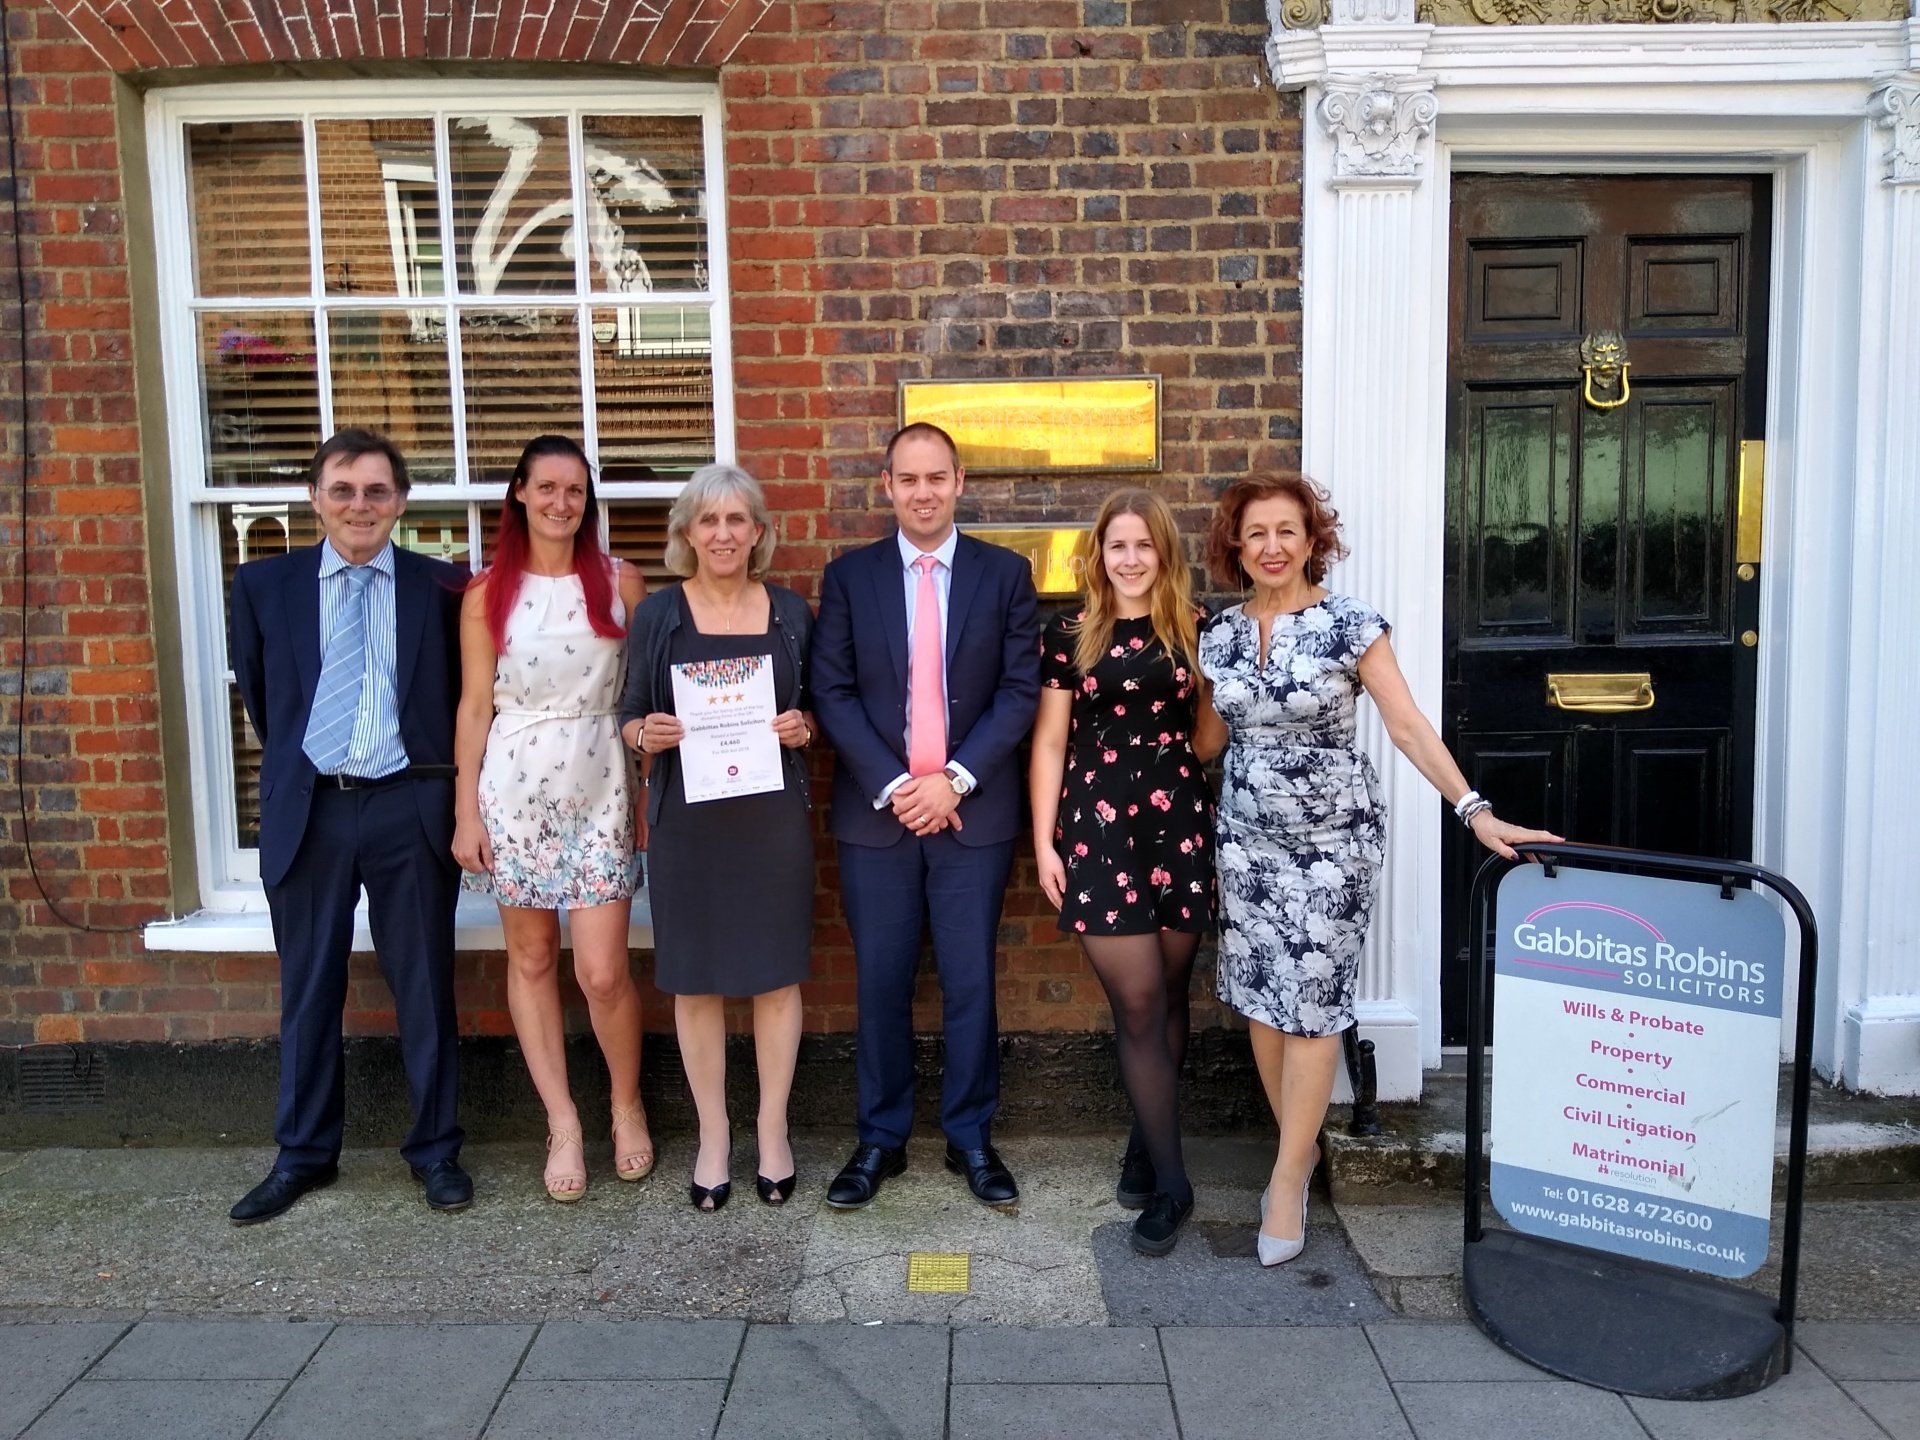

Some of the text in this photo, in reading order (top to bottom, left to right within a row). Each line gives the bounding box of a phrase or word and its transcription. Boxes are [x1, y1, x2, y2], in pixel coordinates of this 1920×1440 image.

[1513, 922, 1766, 984] Gabbitas Robins
[1623, 970, 1766, 1005] SOLICITORS
[1563, 1000, 1705, 1036] Wills & Probate
[1590, 1040, 1673, 1068] Property
[1576, 1073, 1686, 1106] Commercial
[1563, 1105, 1697, 1144] Civil Litigation
[1572, 1141, 1685, 1178] Matrimonial
[1610, 1169, 1657, 1184] resolution
[1543, 1186, 1713, 1231] Tel: 01628 472600
[1511, 1201, 1747, 1265] www.gabbitasrobins.co.uk
